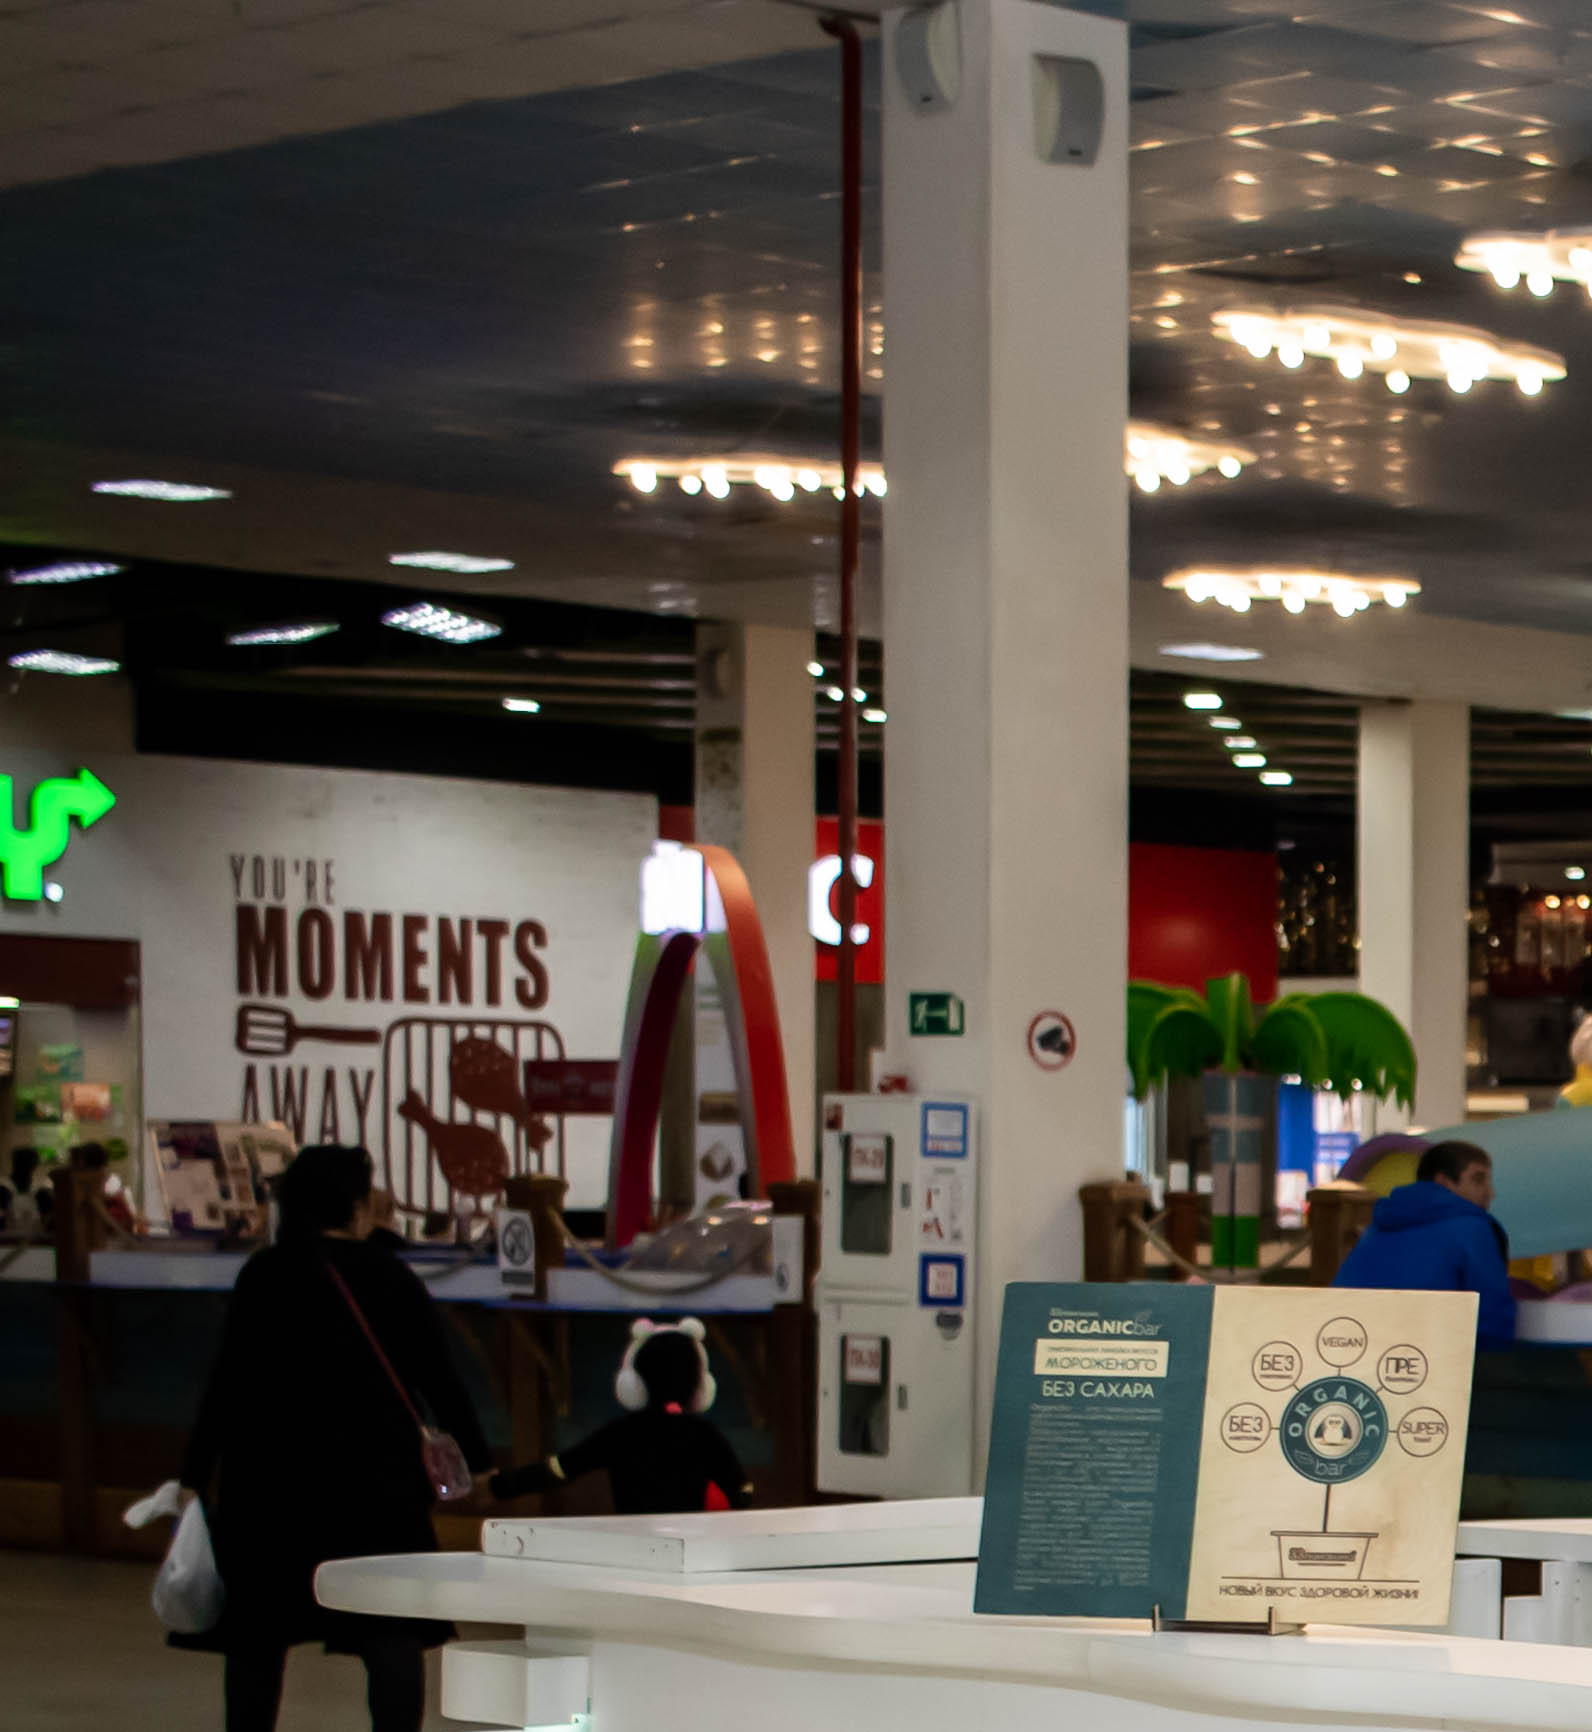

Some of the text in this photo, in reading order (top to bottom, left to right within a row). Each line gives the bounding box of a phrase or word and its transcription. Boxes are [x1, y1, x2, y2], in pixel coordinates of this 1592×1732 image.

[230, 854, 336, 905] YOU'RE
[236, 904, 551, 1011] MOMENTS
[1322, 1336, 1364, 1348] VEGAN
[1044, 1357, 1158, 1372] МОРОЖЕНОГО
[1260, 1354, 1295, 1372] БЕЗ
[1385, 1357, 1420, 1375] ПРЕ
[1042, 1380, 1154, 1399] БЕЗ САХАРА
[1288, 1385, 1380, 1438] ORGANIC
[1229, 1415, 1264, 1433] БЕЗ
[1402, 1421, 1445, 1435] SUPER
[1314, 1460, 1347, 1476] bar
[1219, 1583, 1264, 1597] НОВЫЙ
[1264, 1586, 1297, 1598] ВКУС
[1299, 1586, 1371, 1599] ЗДОРОВОЙ
